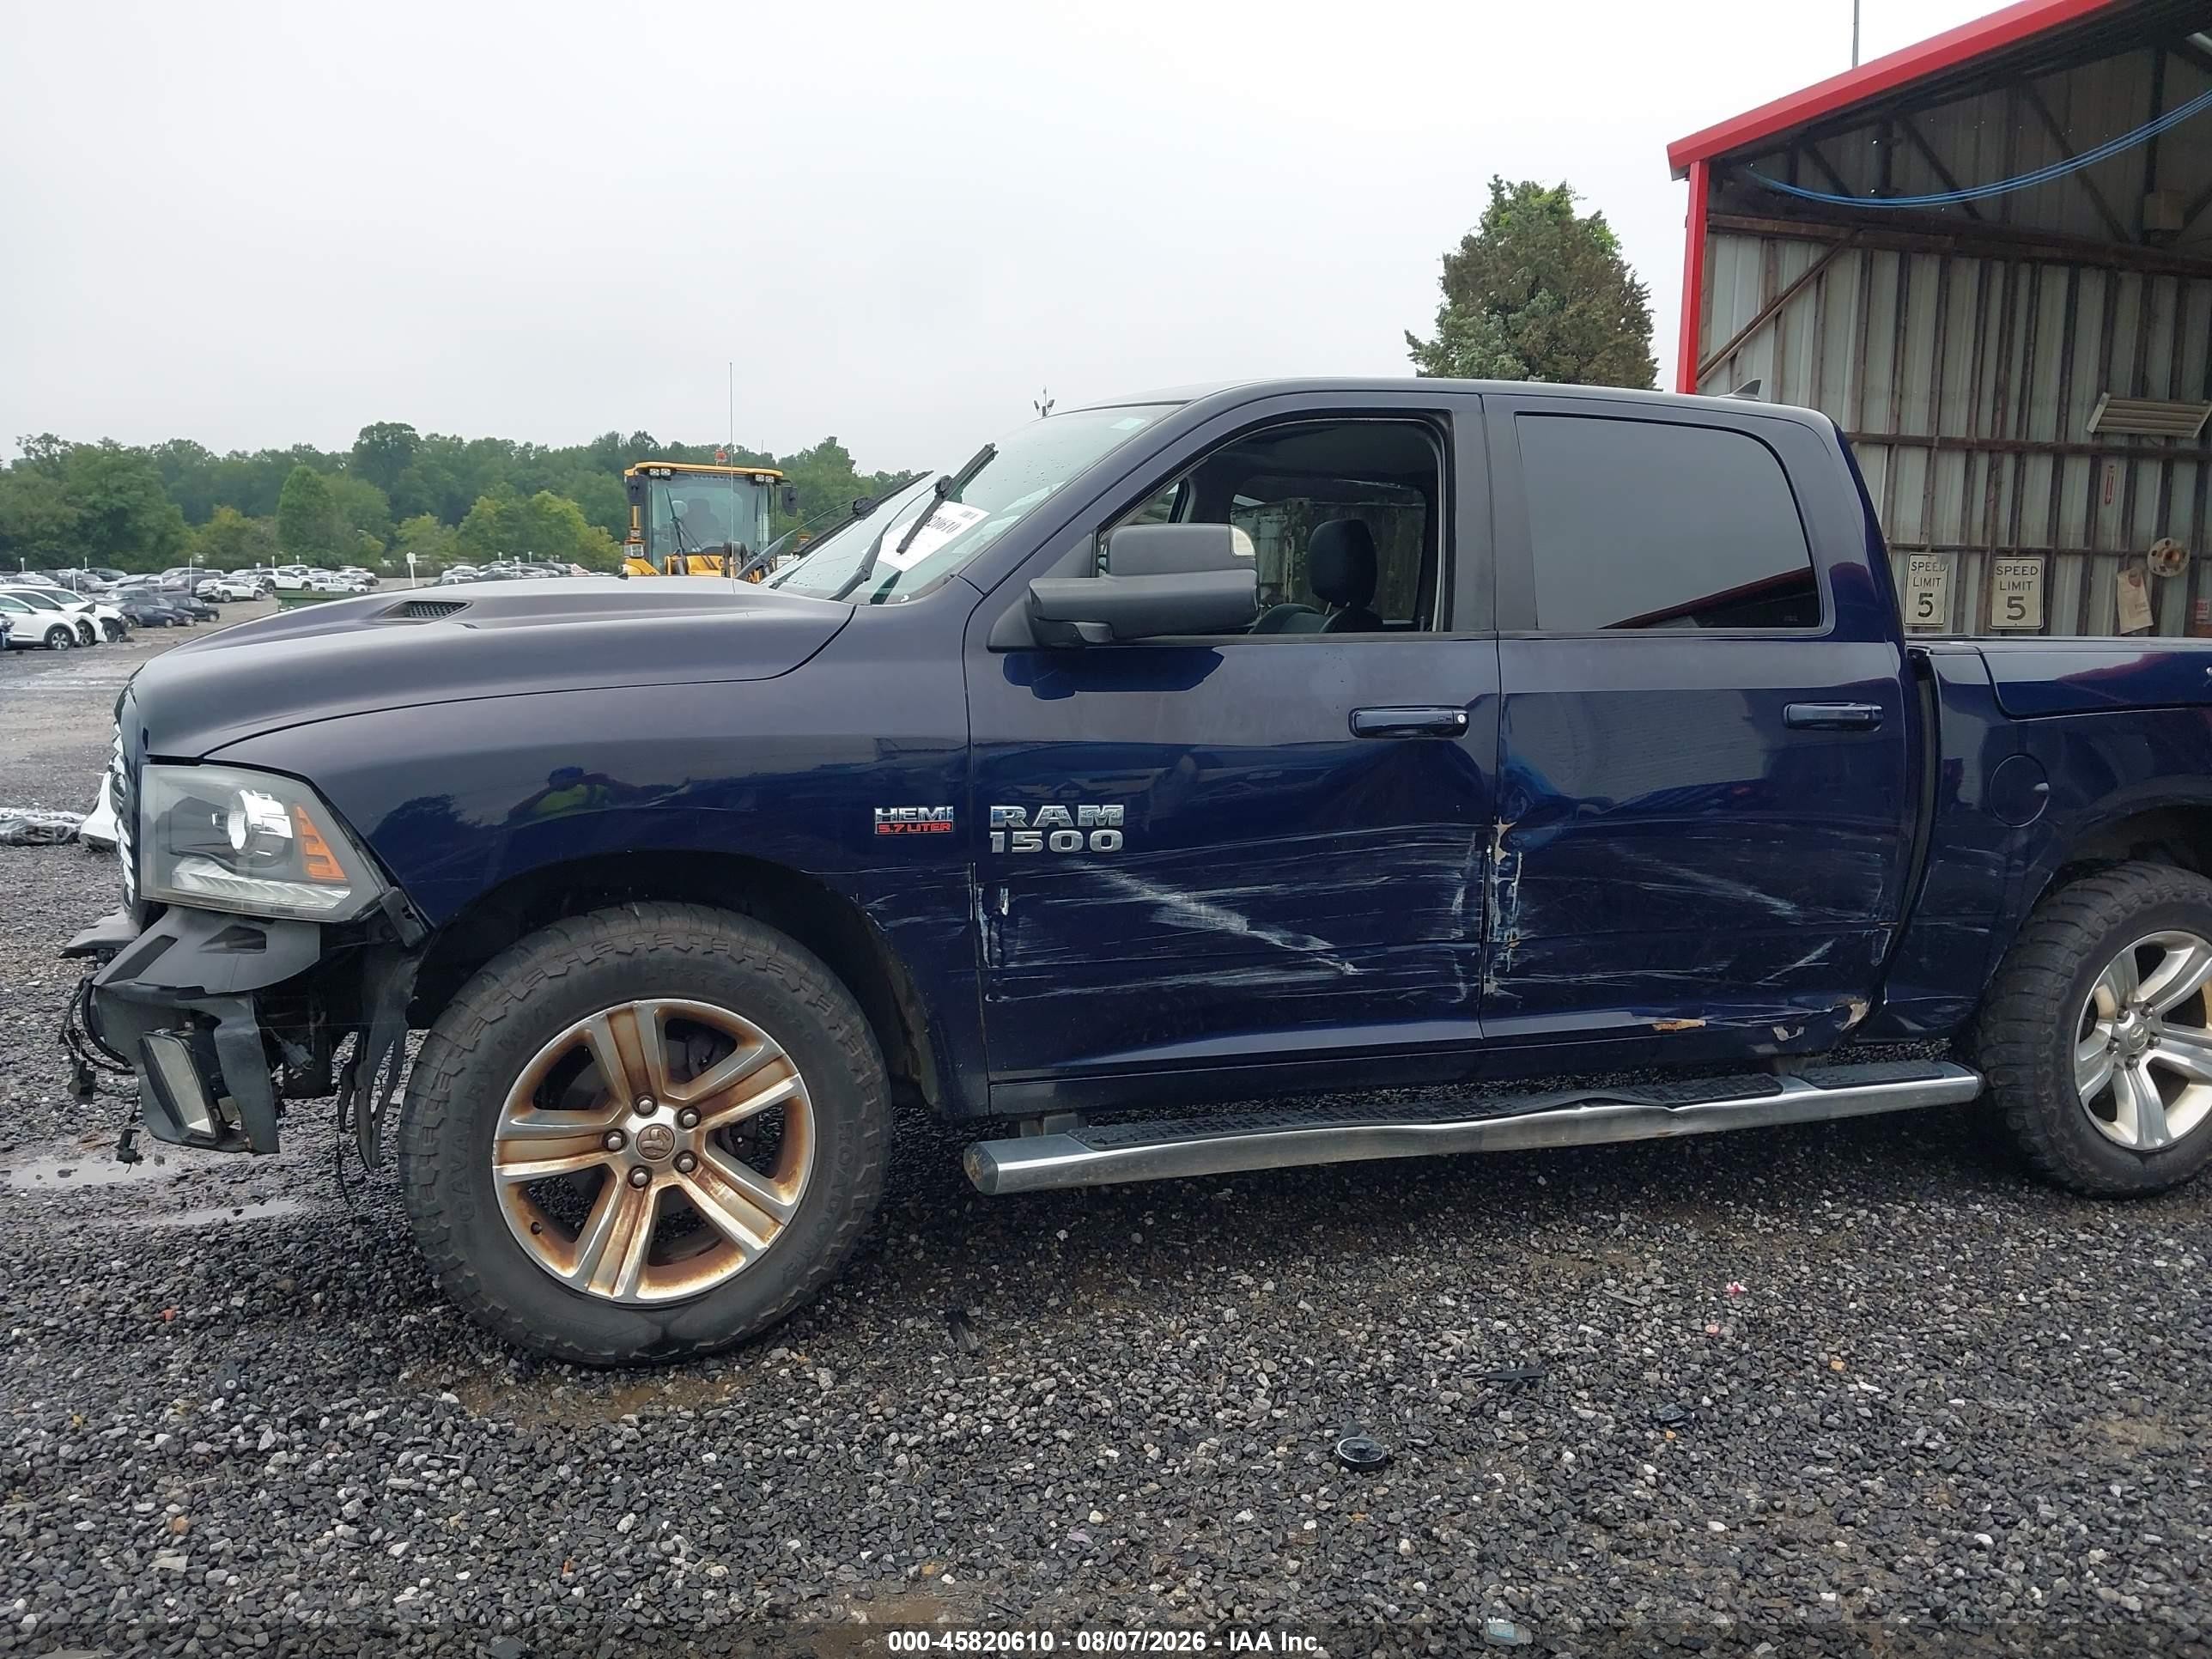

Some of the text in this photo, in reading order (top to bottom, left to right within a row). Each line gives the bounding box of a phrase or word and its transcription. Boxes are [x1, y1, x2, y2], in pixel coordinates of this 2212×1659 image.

[1911, 561, 1948, 573] SPEED
[1996, 565, 2039, 577] SPEED
[1912, 577, 1942, 587] LIMIT
[1999, 580, 2033, 591] LIMIT
[1917, 592, 1934, 618] 5
[2006, 595, 2027, 621] 5
[874, 805, 954, 822] HEMI
[990, 805, 1125, 828] RAM
[878, 822, 951, 833] 5.7 LITER
[989, 830, 1124, 854] 1500
